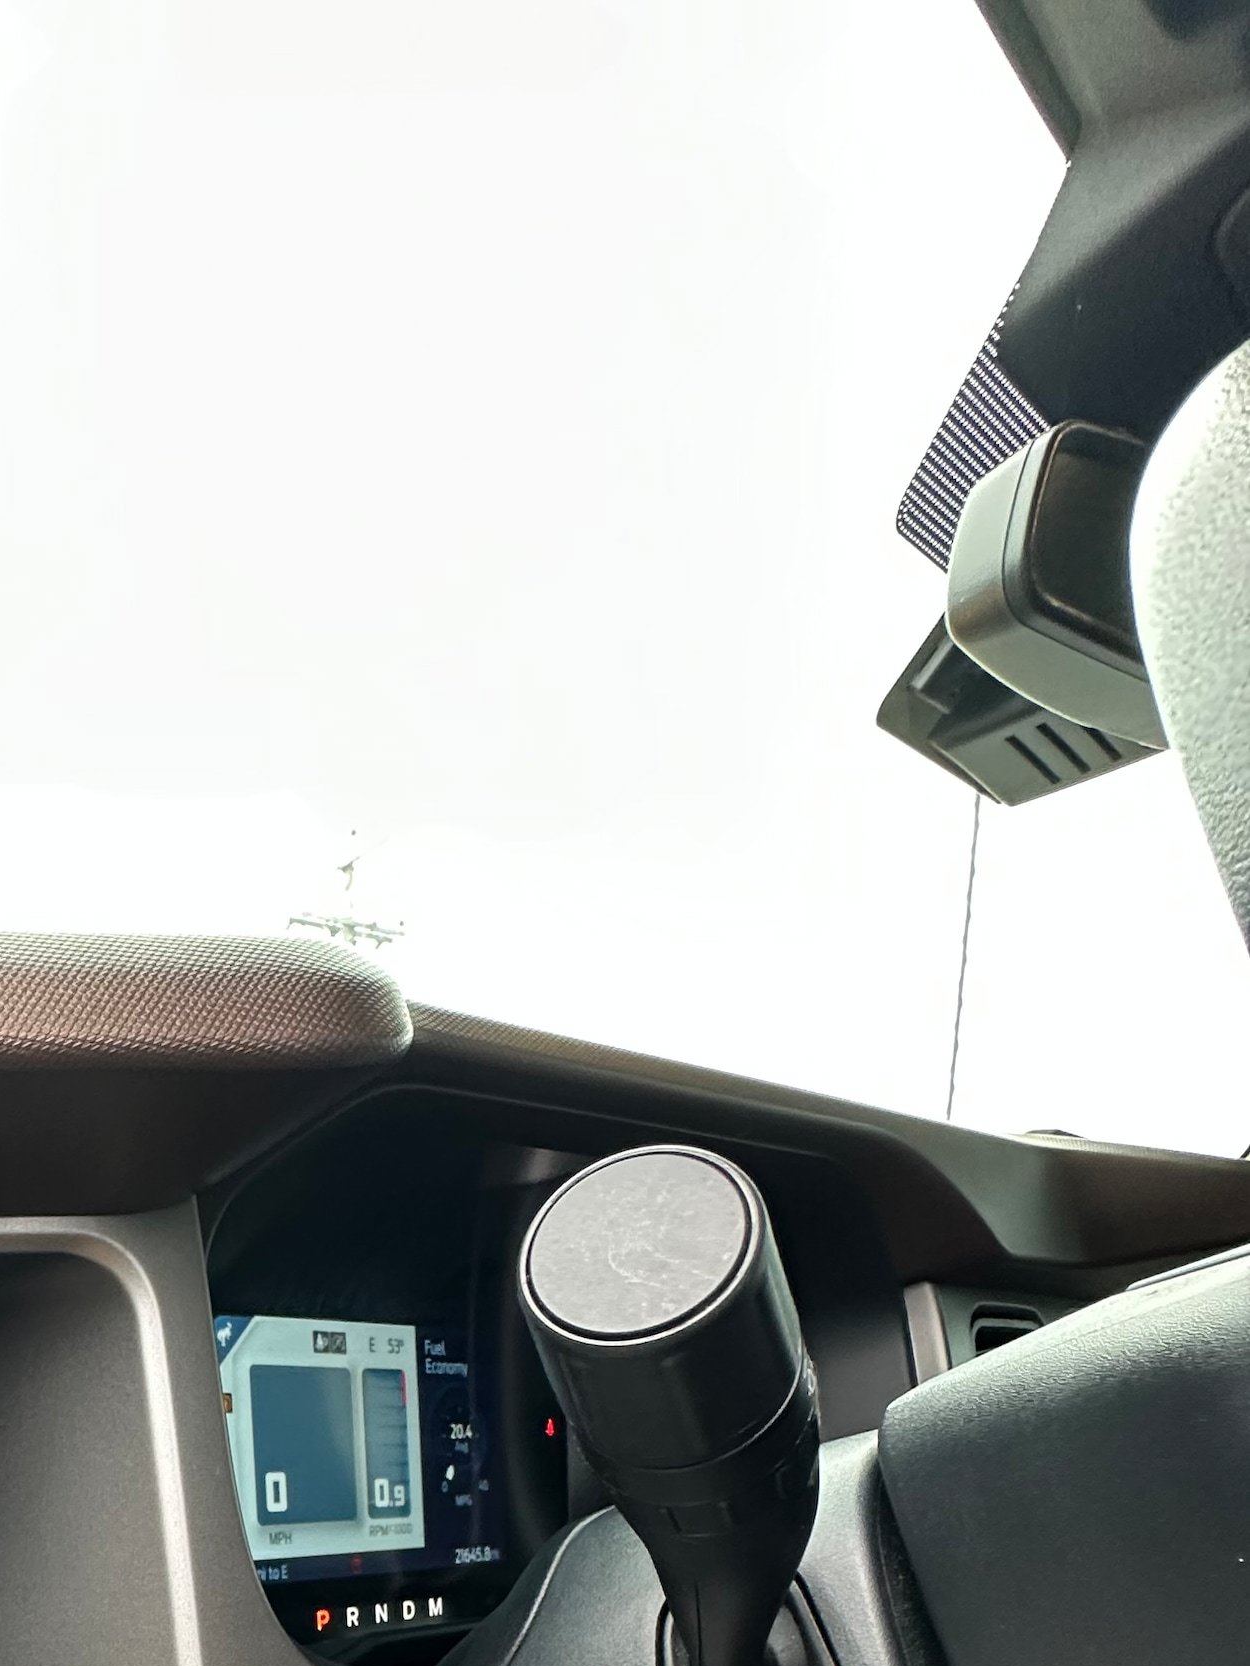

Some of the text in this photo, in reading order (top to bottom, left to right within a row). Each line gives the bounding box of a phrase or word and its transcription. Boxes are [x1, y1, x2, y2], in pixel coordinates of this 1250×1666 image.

[369, 1337, 375, 1352] E
[424, 1339, 447, 1356] Fuel
[425, 1358, 469, 1378] Economy
[450, 1423, 473, 1440] 20.4
[265, 1471, 288, 1513] 0
[373, 1477, 406, 1508] 0.9
[269, 1531, 293, 1546] MPH
[268, 1565, 279, 1581] to
[280, 1564, 288, 1580] E
[316, 1597, 444, 1632] P R N D M
